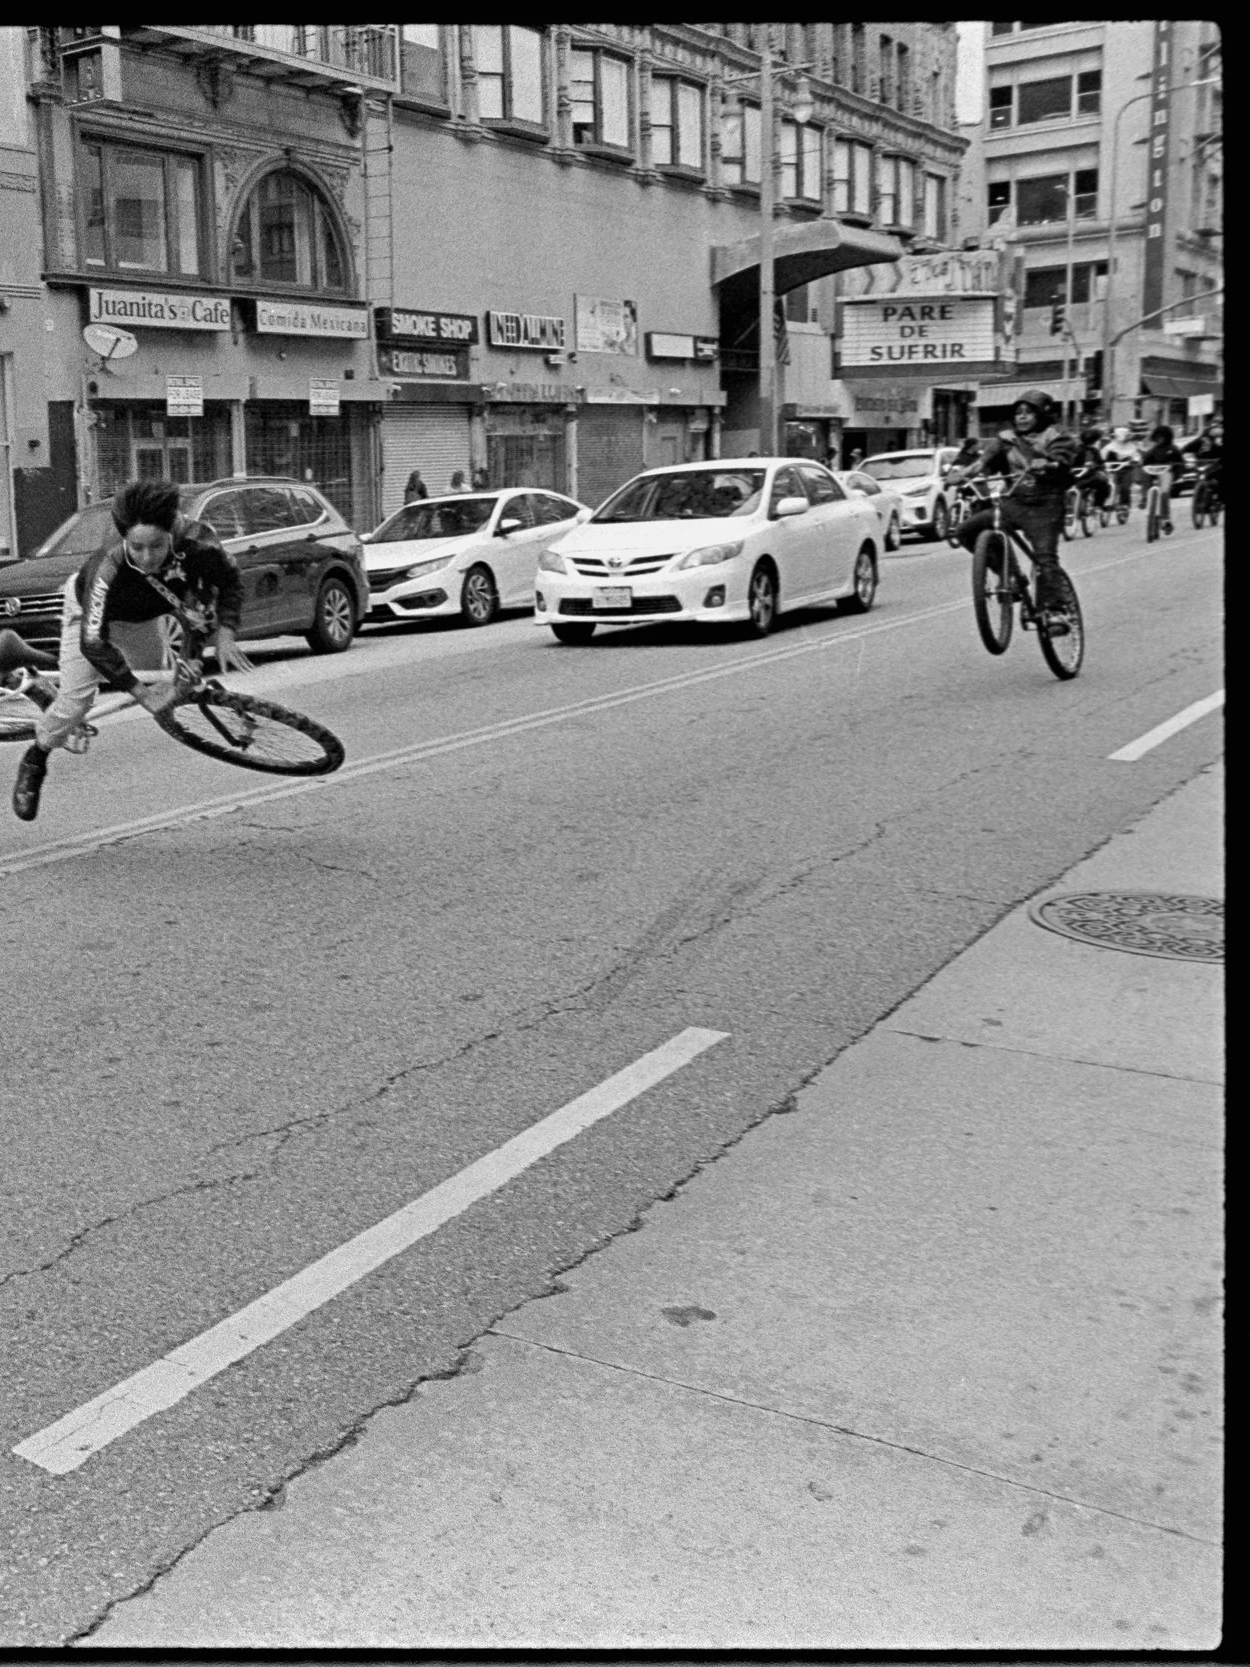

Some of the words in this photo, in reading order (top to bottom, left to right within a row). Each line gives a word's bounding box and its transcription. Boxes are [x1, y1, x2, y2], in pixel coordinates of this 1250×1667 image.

[94, 291, 178, 320] Juanita's
[191, 300, 230, 324] Cafe
[882, 304, 955, 323] PARE
[259, 308, 307, 329] Comida
[310, 313, 367, 333] Mexicana
[391, 312, 437, 337] SMOKE
[439, 317, 473, 340] SHOP
[900, 325, 929, 339] DE
[869, 342, 966, 362] SUFRIR
